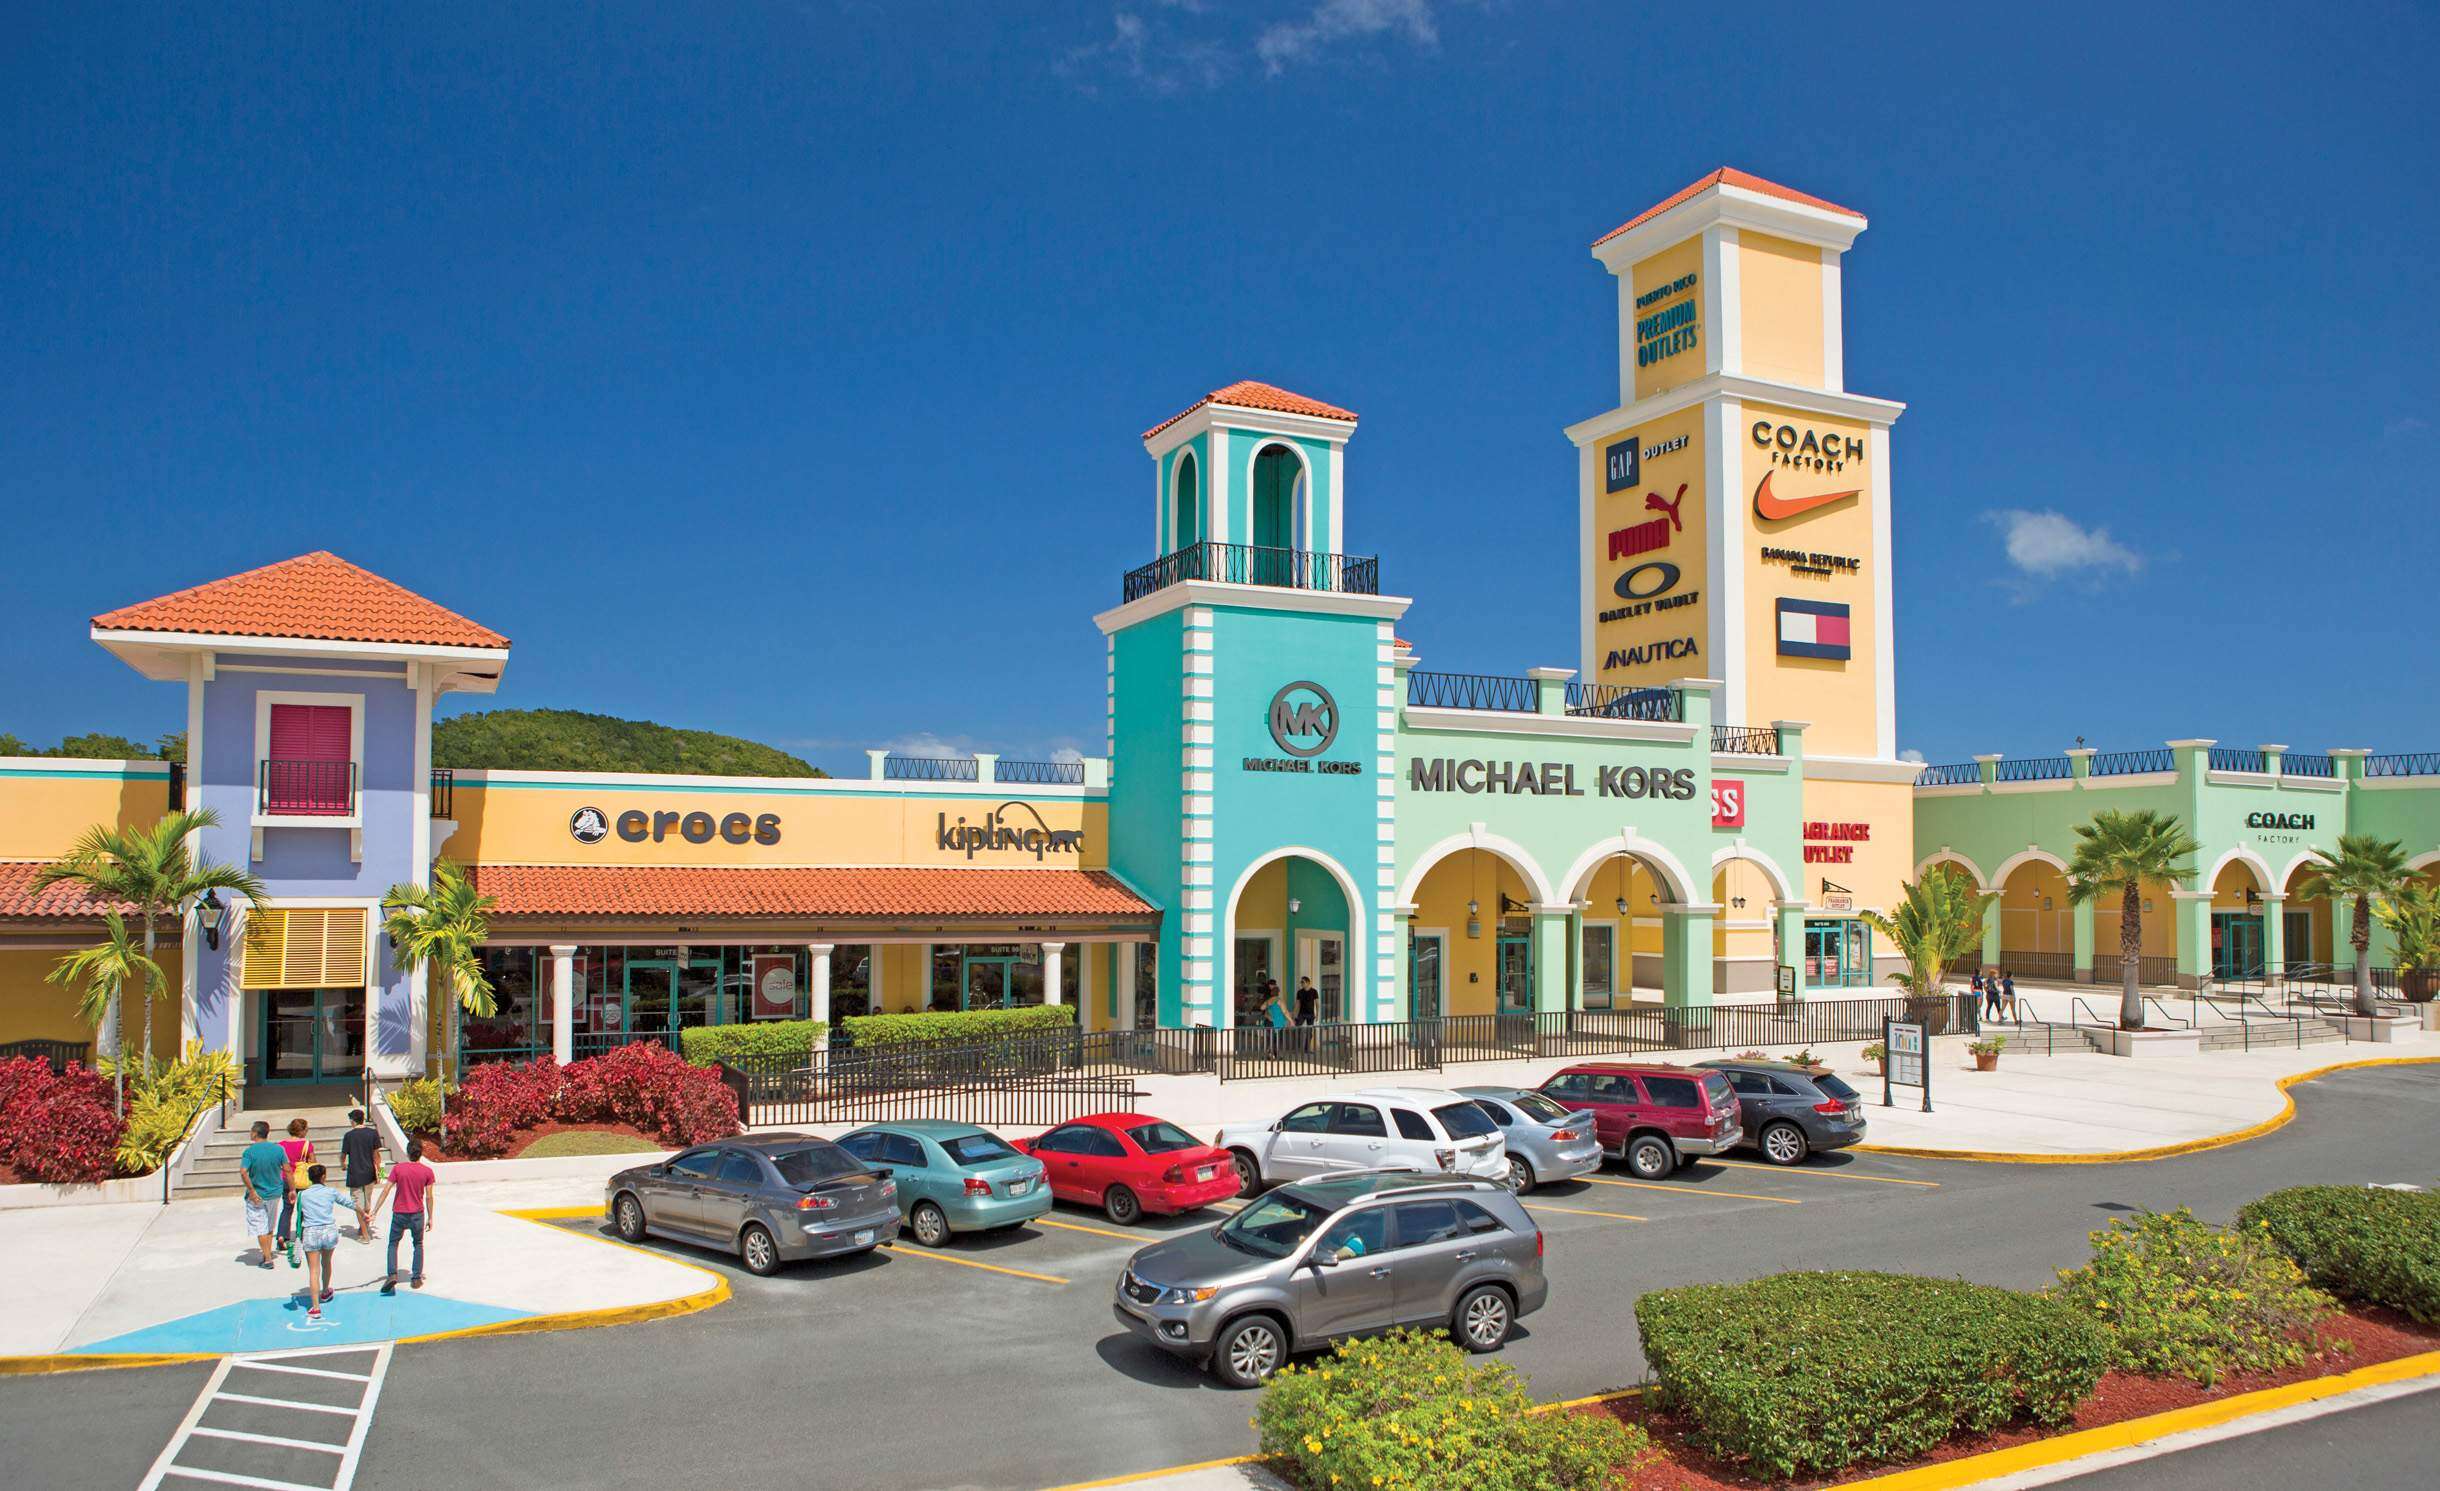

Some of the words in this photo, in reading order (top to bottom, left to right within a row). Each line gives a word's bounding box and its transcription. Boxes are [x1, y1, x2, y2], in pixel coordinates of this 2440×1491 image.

[1637, 285, 1673, 309] PUERTO
[1673, 273, 1697, 293] RICO
[1637, 299, 1697, 343] PREMIUM
[1638, 325, 1697, 367] OUTLETS
[1610, 450, 1632, 481] GAP
[1643, 435, 1689, 460] OUTLET
[1752, 421, 1863, 461] COACH
[1772, 451, 1844, 472] FACTORY
[1609, 518, 1670, 561] PUMA
[1761, 546, 1808, 562] BANANA
[1809, 553, 1860, 569] REPUBLIC
[1599, 602, 1652, 623] OAKLEY
[1654, 591, 1699, 612] VAULT
[1603, 637, 1699, 670] NAUTICA
[1242, 758, 1314, 774] MICHAEL
[1317, 760, 1362, 775] KORS
[1411, 757, 1585, 796] MICHAEL
[1599, 765, 1697, 801] KORS
[616, 809, 781, 846] crocs
[2247, 811, 2315, 830] COACH
[2257, 834, 2300, 844] FACTORY
